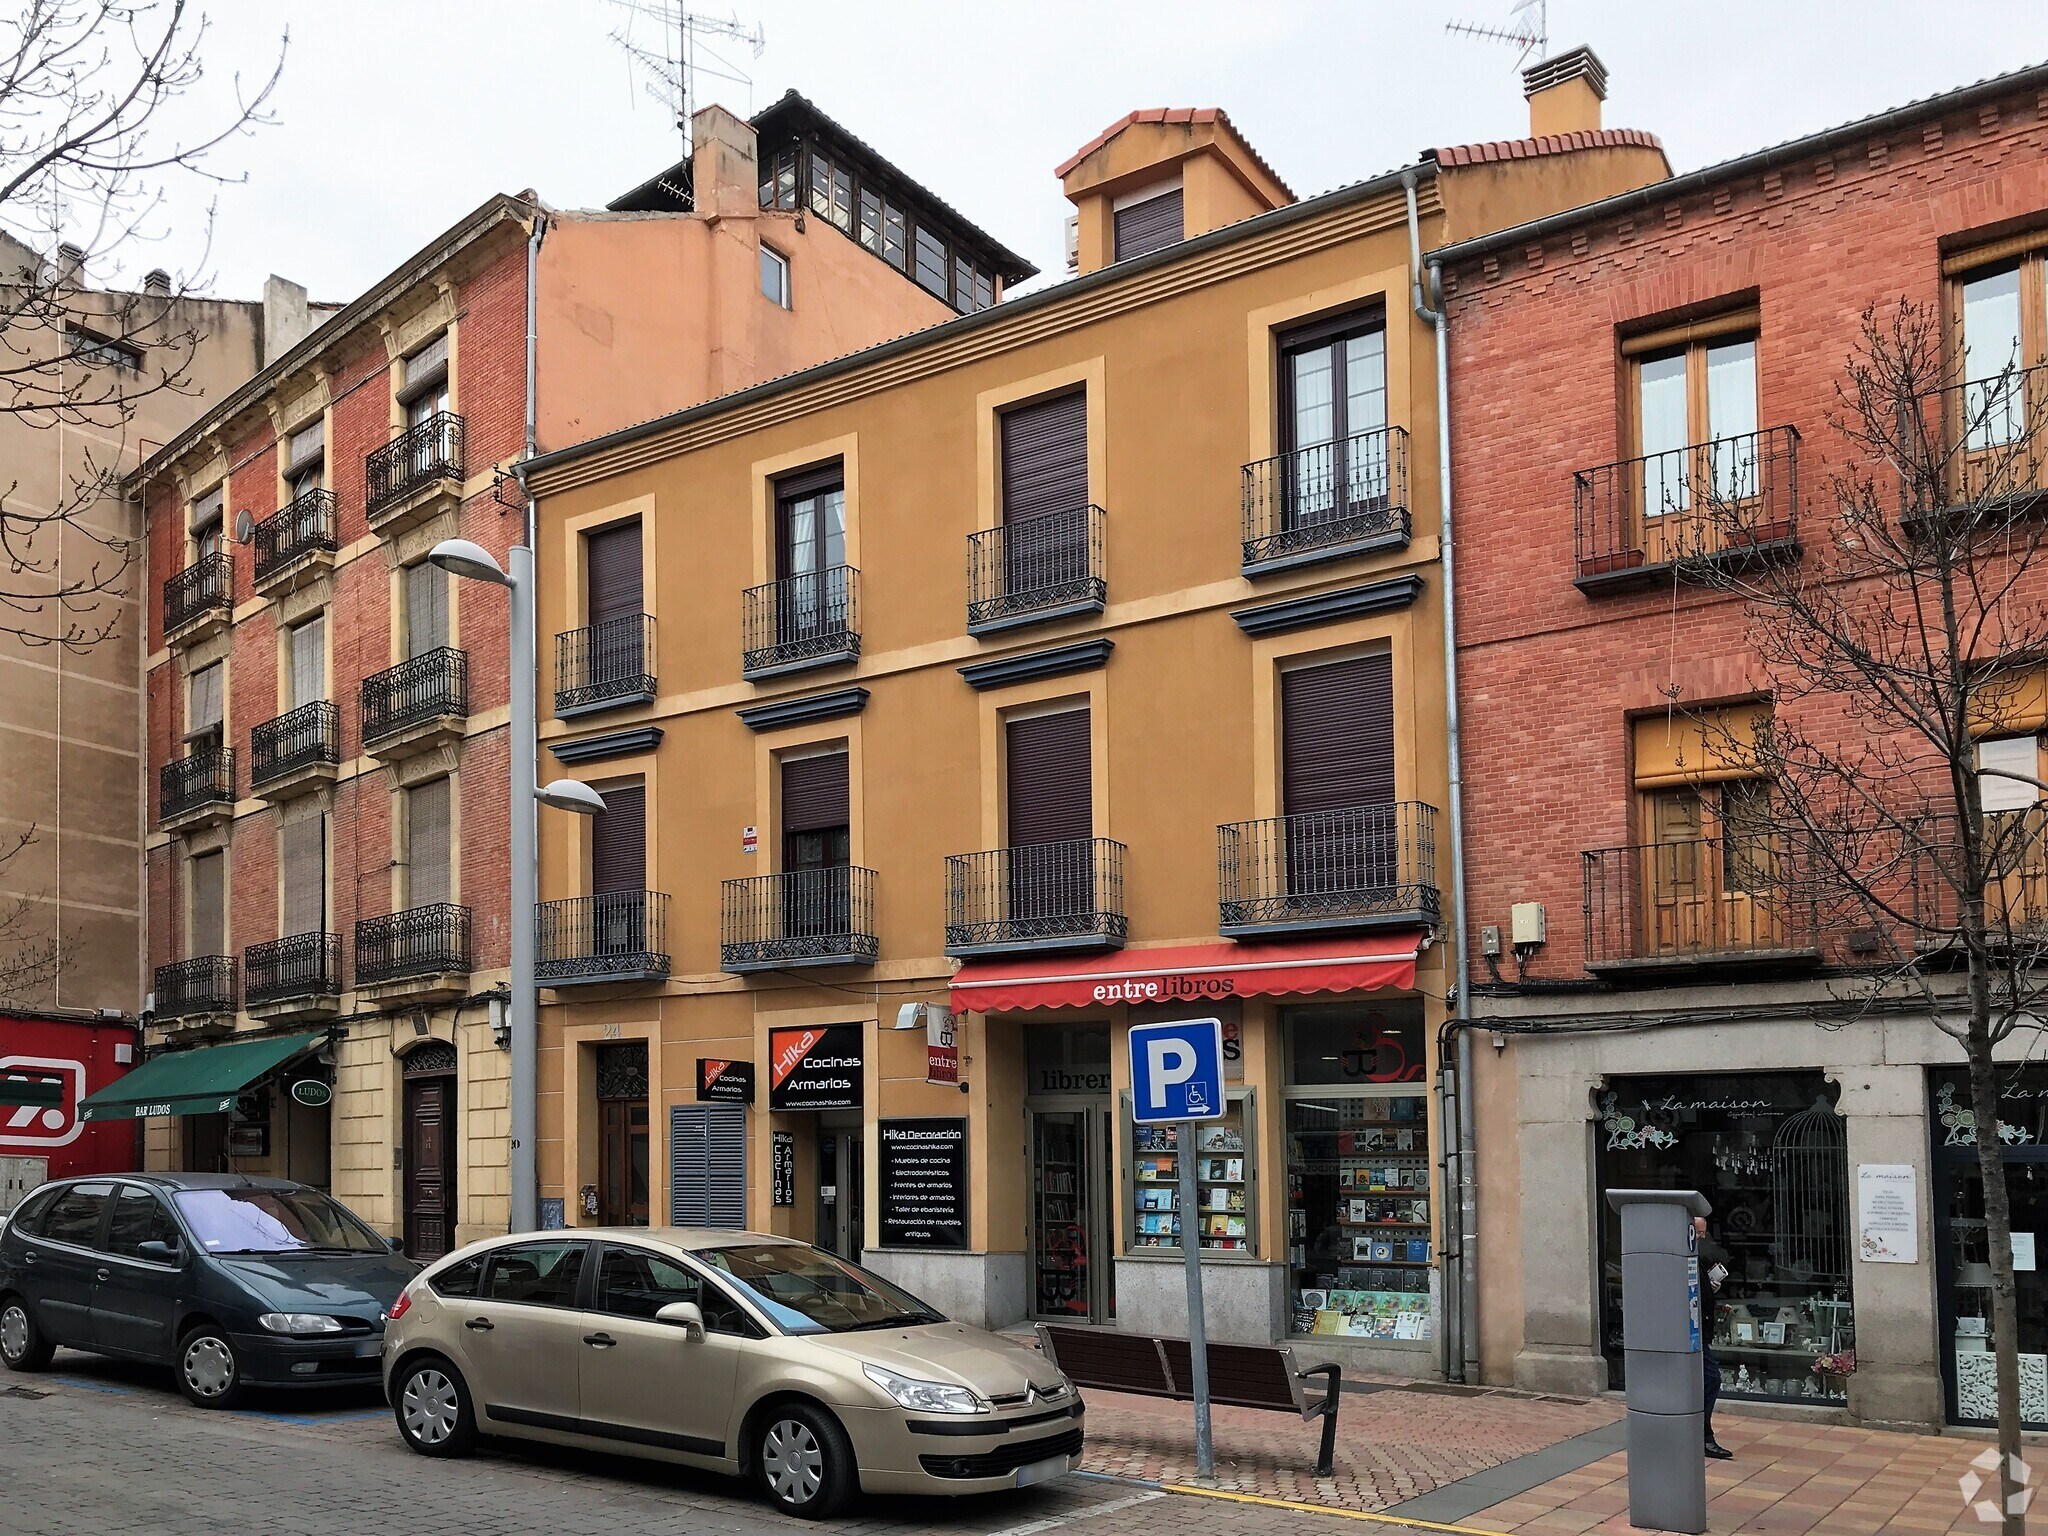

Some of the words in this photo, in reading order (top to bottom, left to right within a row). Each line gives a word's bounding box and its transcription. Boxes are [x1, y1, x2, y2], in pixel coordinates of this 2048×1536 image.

[1094, 979, 1158, 1000] entre
[1161, 977, 1234, 996] libros
[603, 1024, 621, 1039] 24
[773, 1031, 815, 1076] Hika
[804, 1056, 862, 1069] Cocinas
[929, 1055, 957, 1069] entre
[705, 1061, 726, 1083] Hika
[719, 1074, 747, 1083] Cocinas
[1147, 1038, 1197, 1108] P
[711, 1085, 742, 1093] Armarios
[788, 1078, 852, 1090] Armarios
[2001, 1082, 2034, 1099] La
[298, 1086, 327, 1099] LUDOS
[785, 1098, 852, 1107] www.cocinashika.com
[1660, 1094, 1687, 1110] La
[1690, 1095, 1772, 1109] maison
[135, 1105, 148, 1117] BAR
[149, 1103, 171, 1116] LUDOS
[773, 1133, 793, 1143] Hika
[883, 1129, 906, 1140] Hika
[907, 1129, 962, 1140] Decoración
[774, 1145, 782, 1203] Cocinas
[783, 1146, 793, 1203] Armarios
[905, 1230, 931, 1238] antiguos
